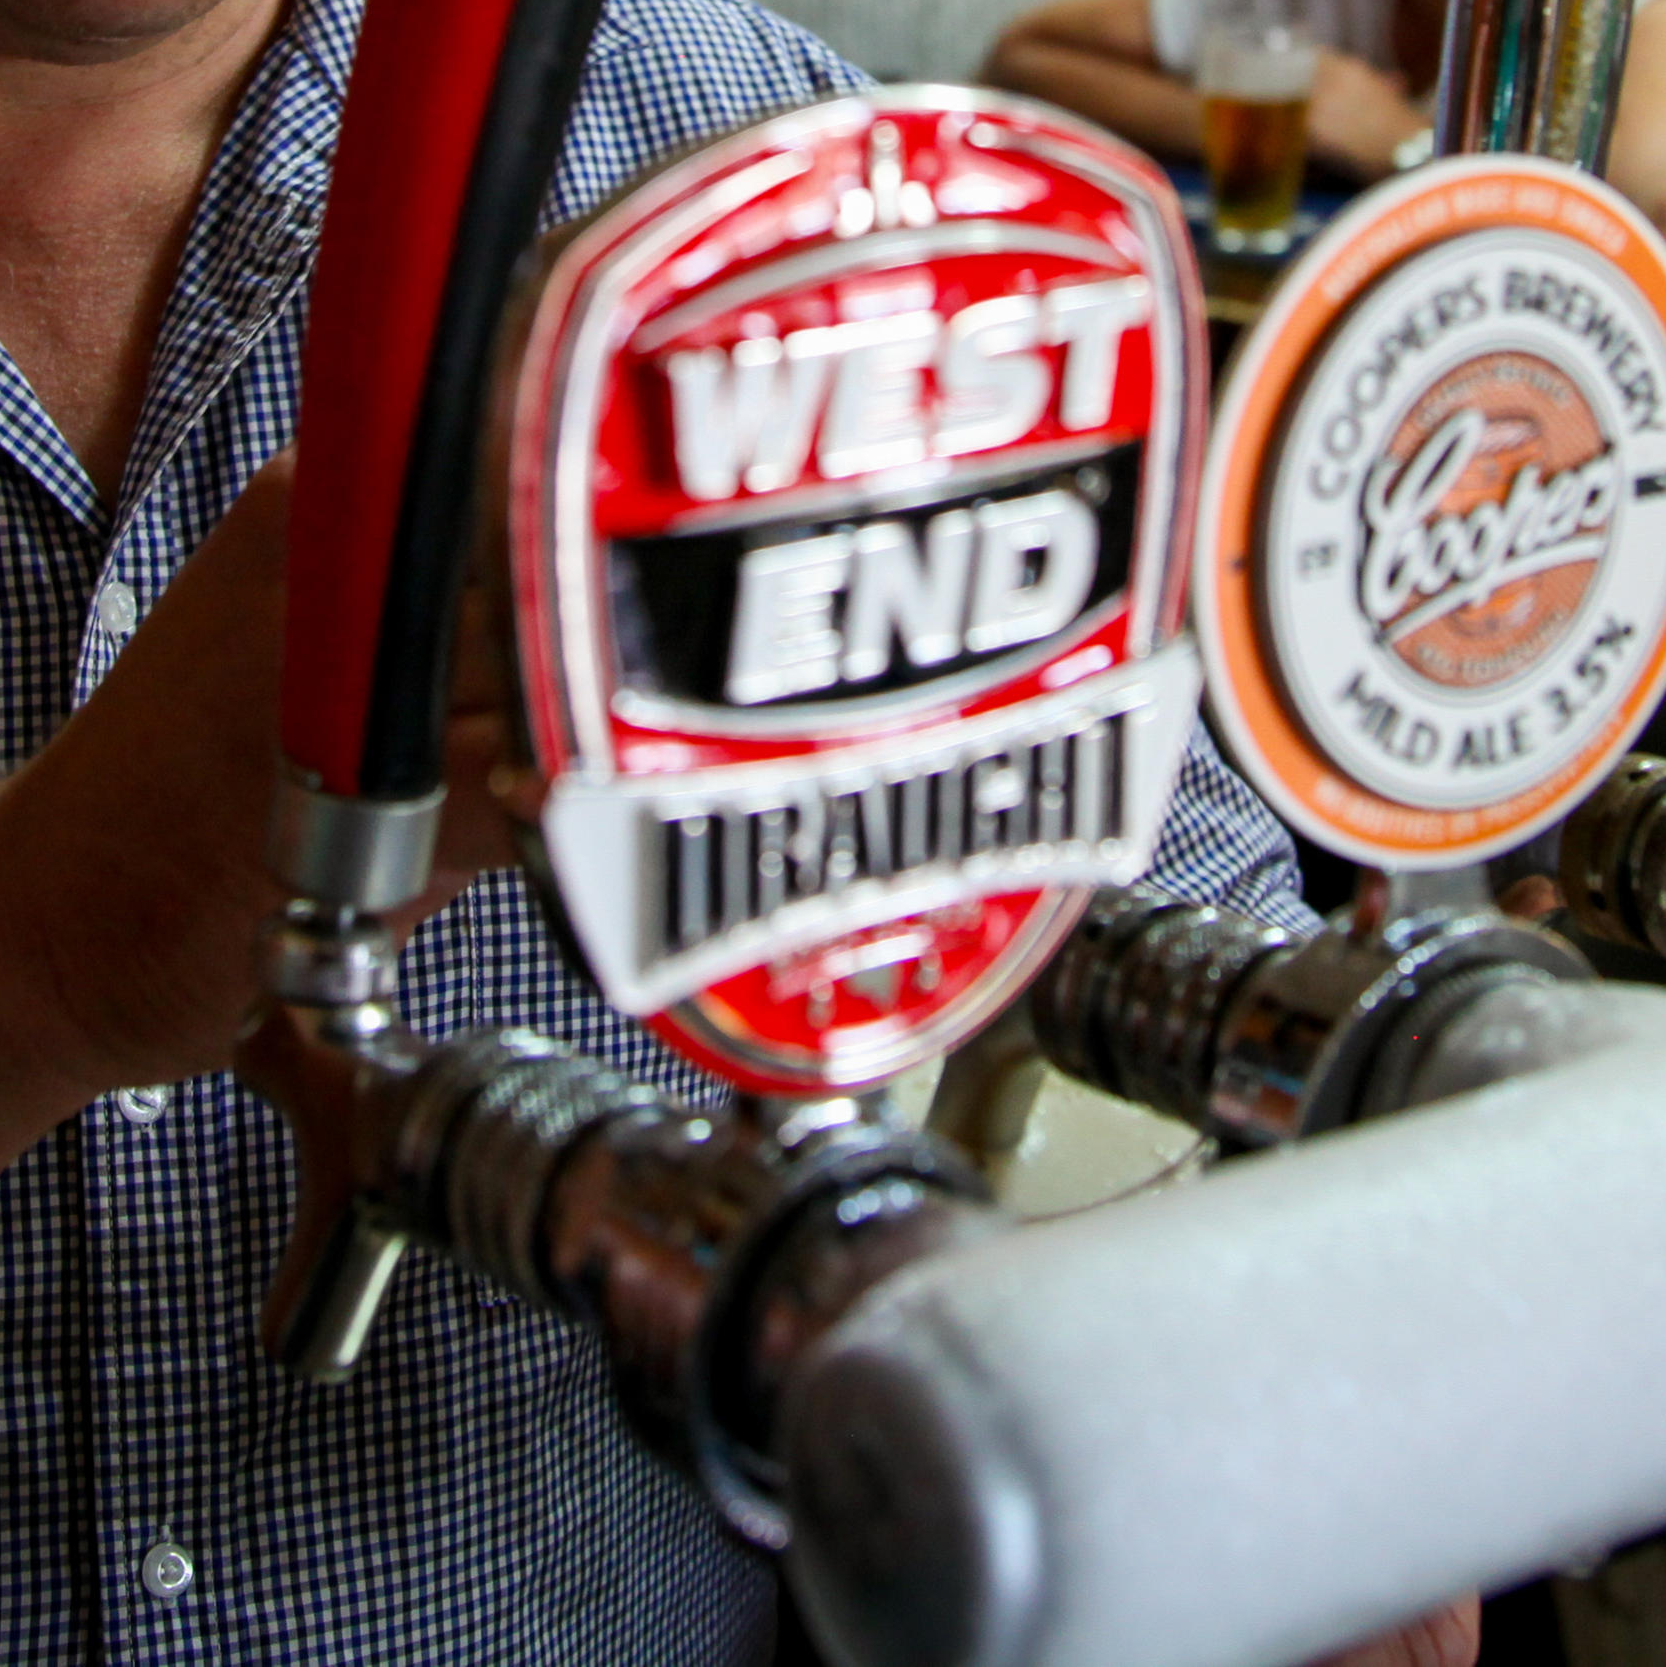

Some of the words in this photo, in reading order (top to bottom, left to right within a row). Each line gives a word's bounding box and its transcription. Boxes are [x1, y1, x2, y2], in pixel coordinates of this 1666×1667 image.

[668, 272, 1151, 502] WEST
[1308, 274, 1488, 501] COOPERS
[1502, 269, 1664, 434] BREWERY
[726, 487, 1101, 707] END
[1363, 409, 1617, 622] Coopers
[1337, 669, 1440, 765] MILD
[1451, 708, 1536, 771] ALE
[1544, 617, 1635, 735] 3.5%
[655, 686, 1157, 958] DRAUGHT
